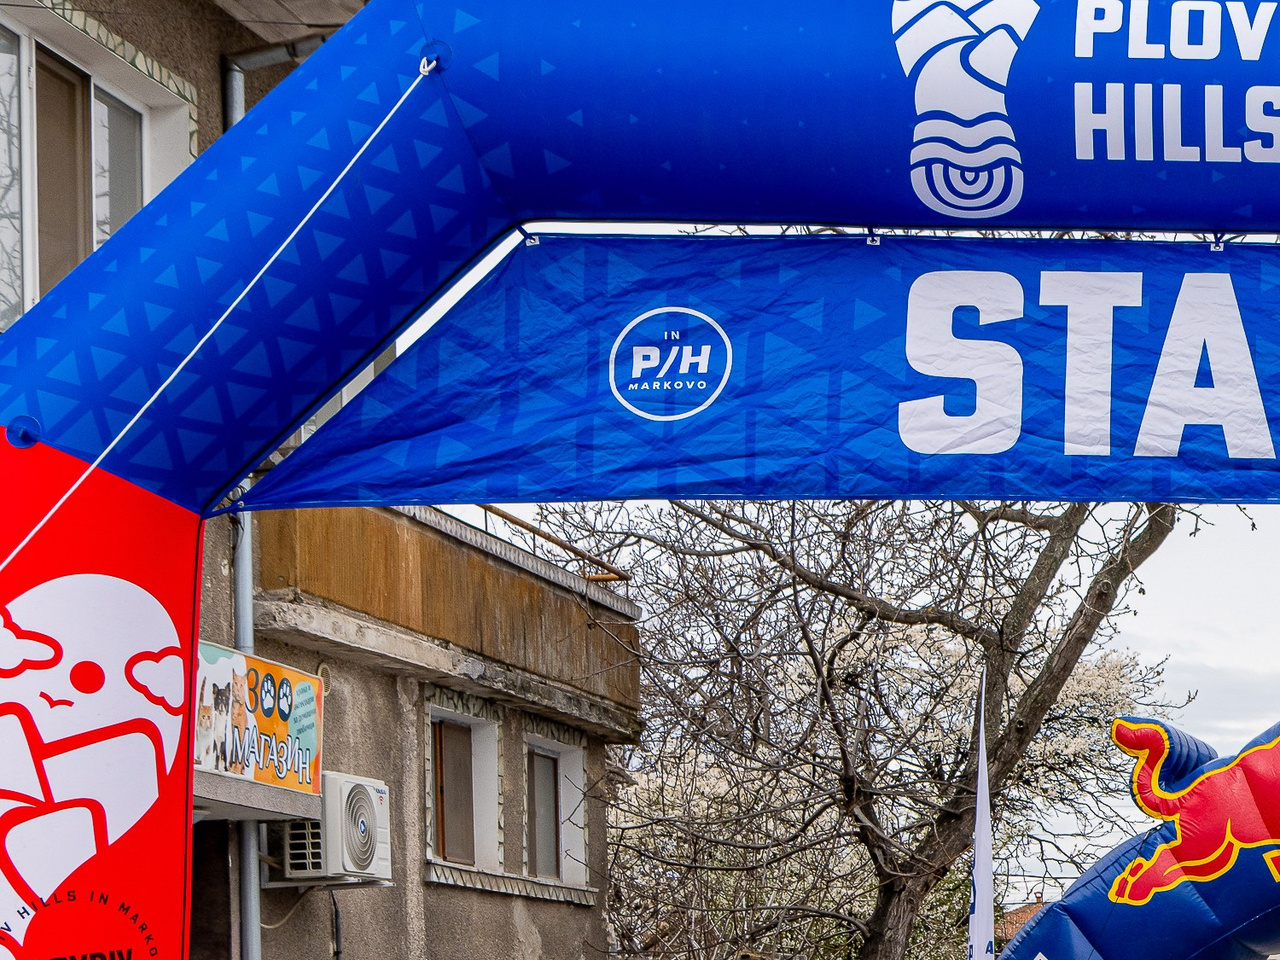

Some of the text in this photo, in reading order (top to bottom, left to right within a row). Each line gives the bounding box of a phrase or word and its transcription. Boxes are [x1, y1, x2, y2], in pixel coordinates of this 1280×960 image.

[664, 331, 680, 340] IN
[631, 345, 712, 378] P/H
[628, 381, 707, 390] MARKOVO
[232, 725, 312, 785] МАГАЗИН
[17, 890, 76, 920] HILLS
[90, 891, 109, 905] IN
